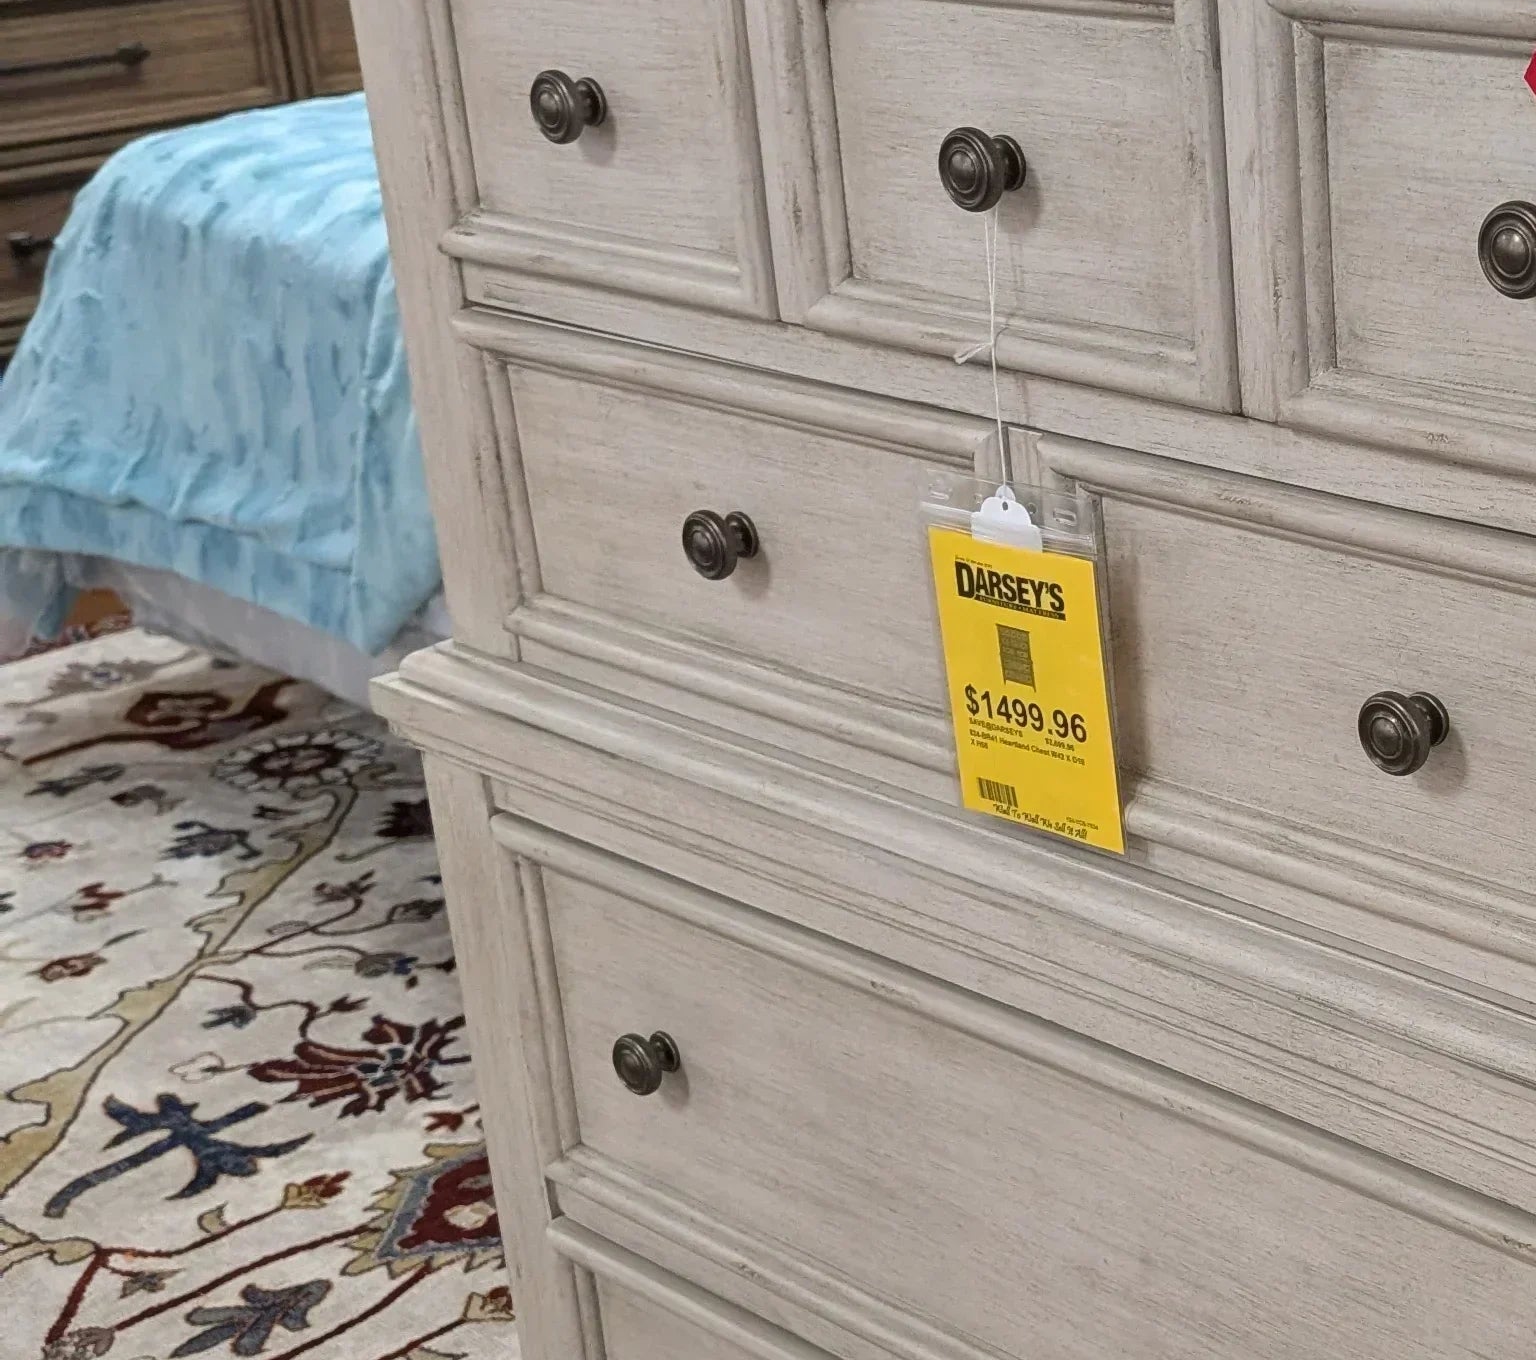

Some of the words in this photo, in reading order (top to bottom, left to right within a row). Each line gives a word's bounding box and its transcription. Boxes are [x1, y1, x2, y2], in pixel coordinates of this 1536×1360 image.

[955, 561, 1065, 611] DARSEY'S
[964, 684, 1087, 743] $1499.96
[1000, 737, 1030, 751] Heartland
[1031, 745, 1050, 757] Chest
